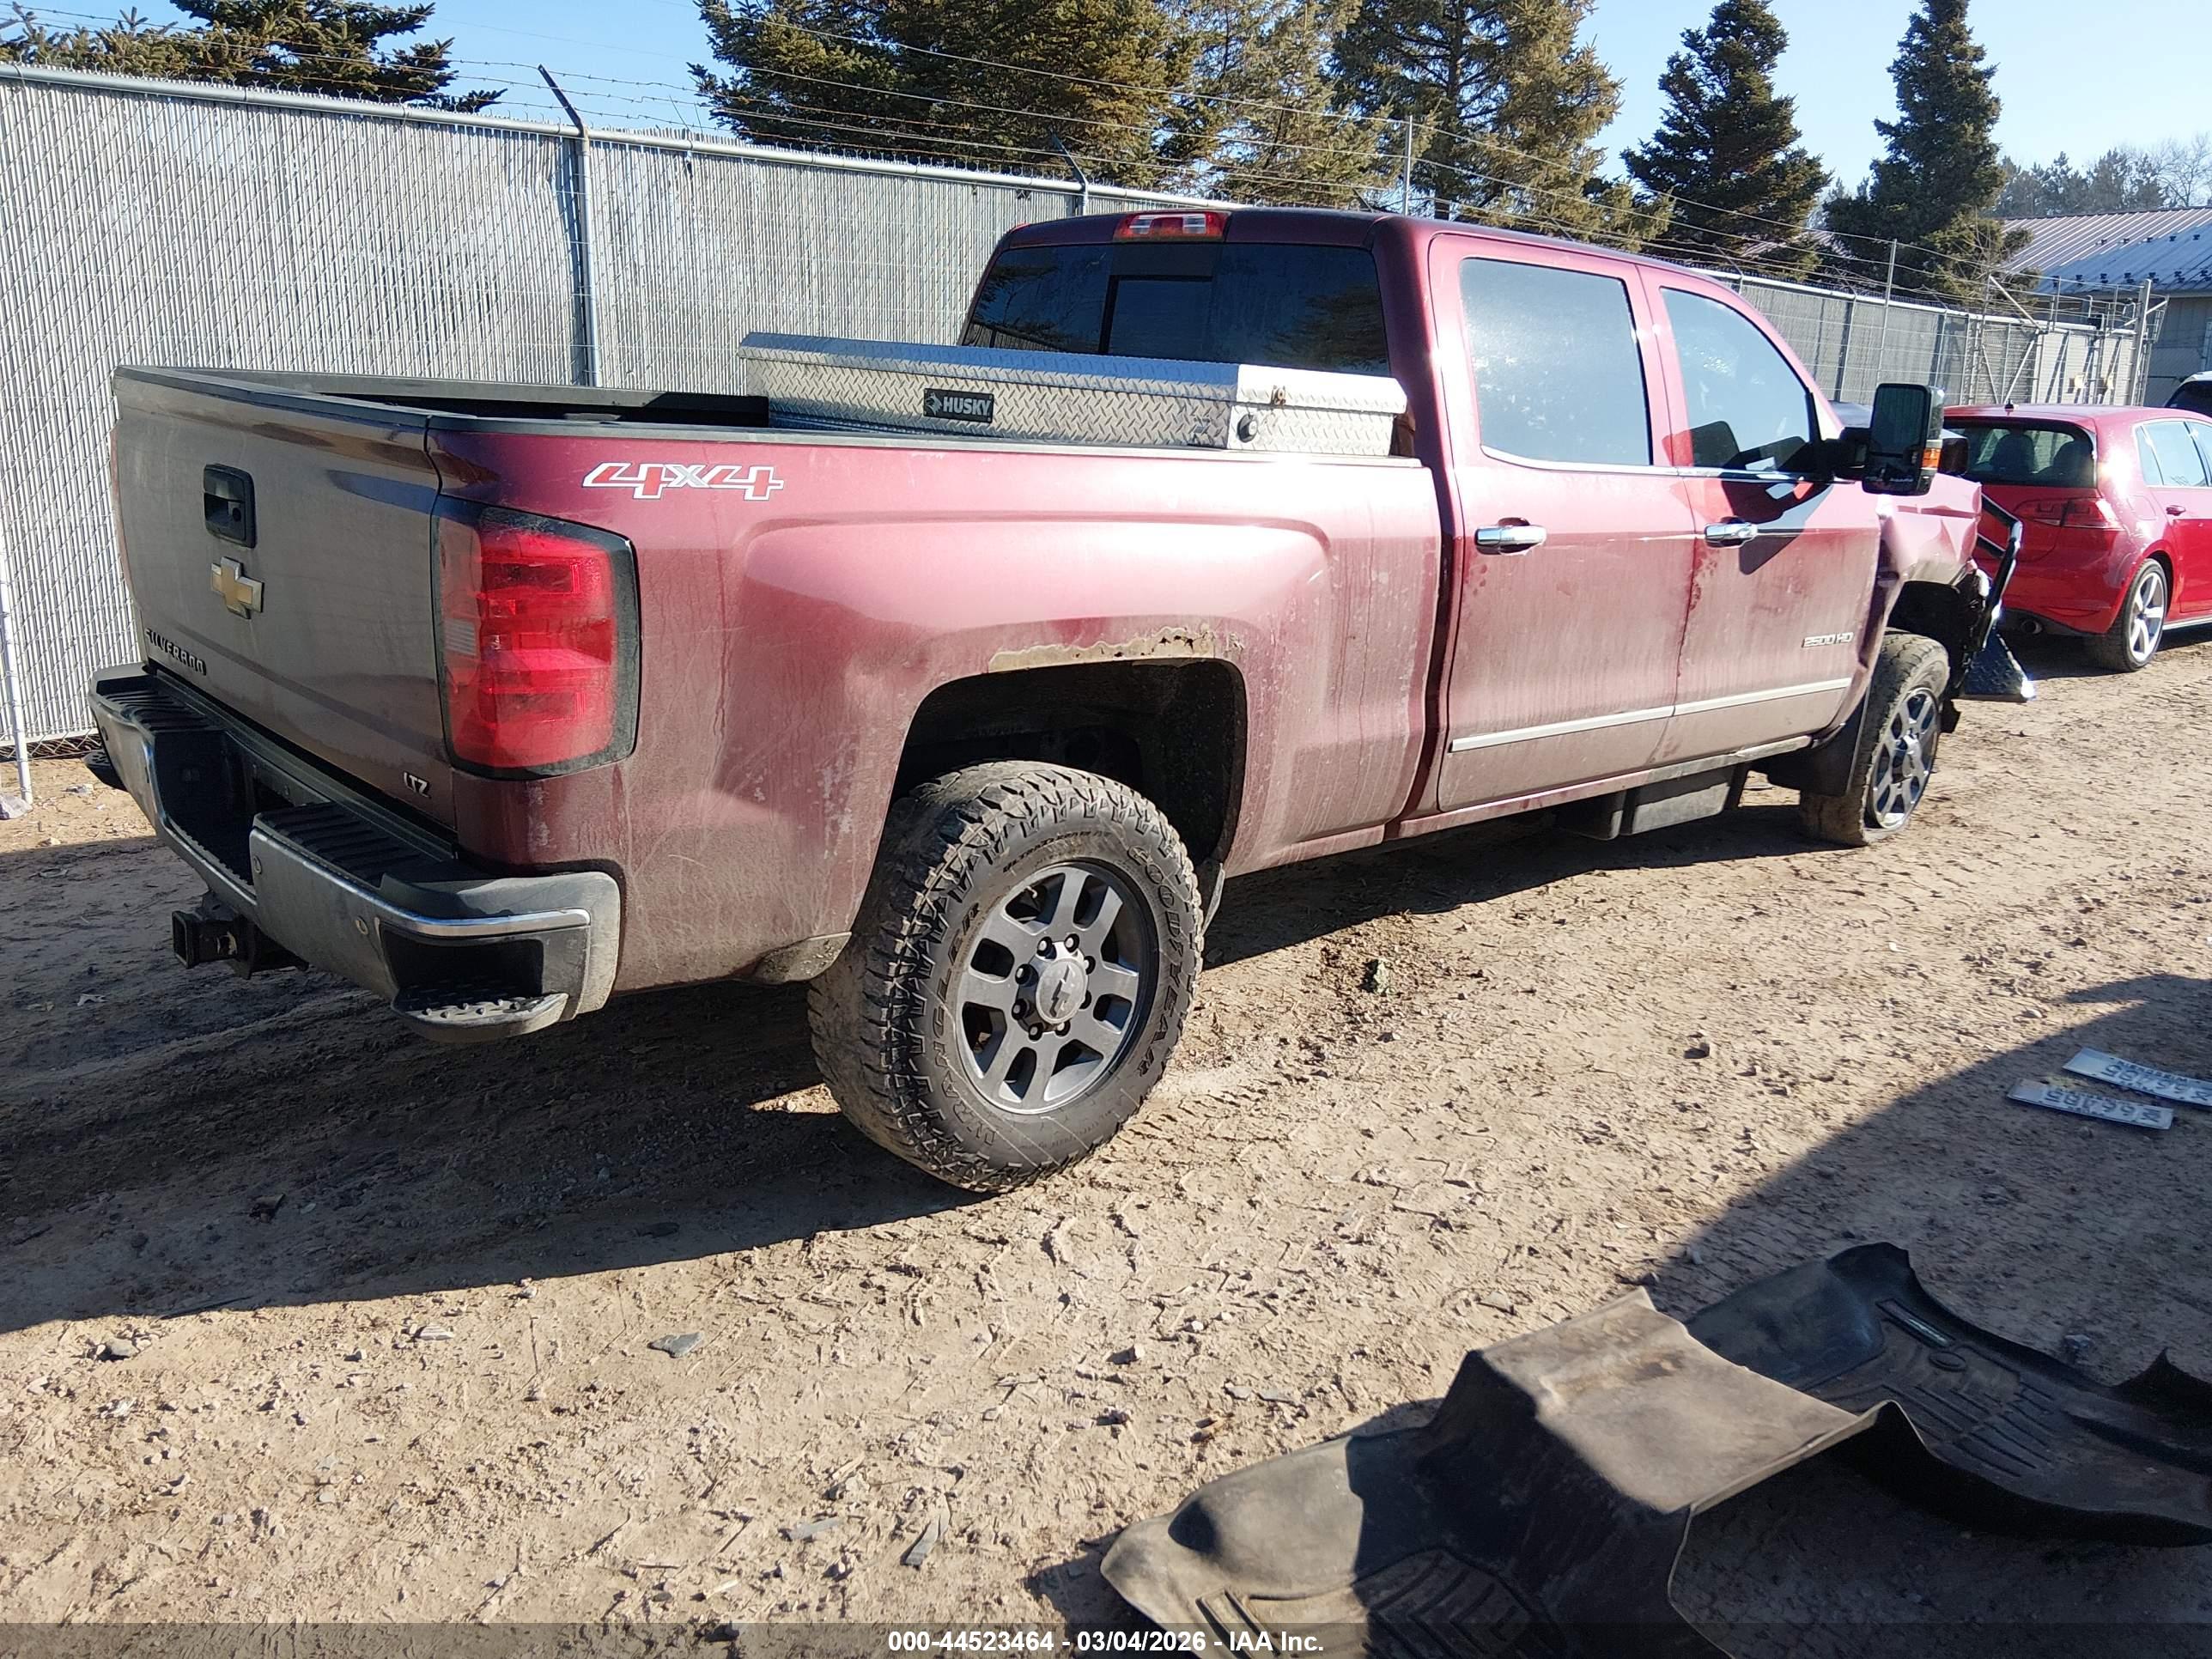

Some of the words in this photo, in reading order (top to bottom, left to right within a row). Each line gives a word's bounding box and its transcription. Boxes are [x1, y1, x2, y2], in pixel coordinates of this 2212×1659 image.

[943, 396, 992, 416] HUSKY
[582, 462, 784, 501] 4x4
[144, 628, 206, 676] SILVERADO
[404, 771, 430, 798] LTZ
[1127, 845, 1184, 1078] GOODYEAR
[933, 902, 995, 1146] WRANGLER
